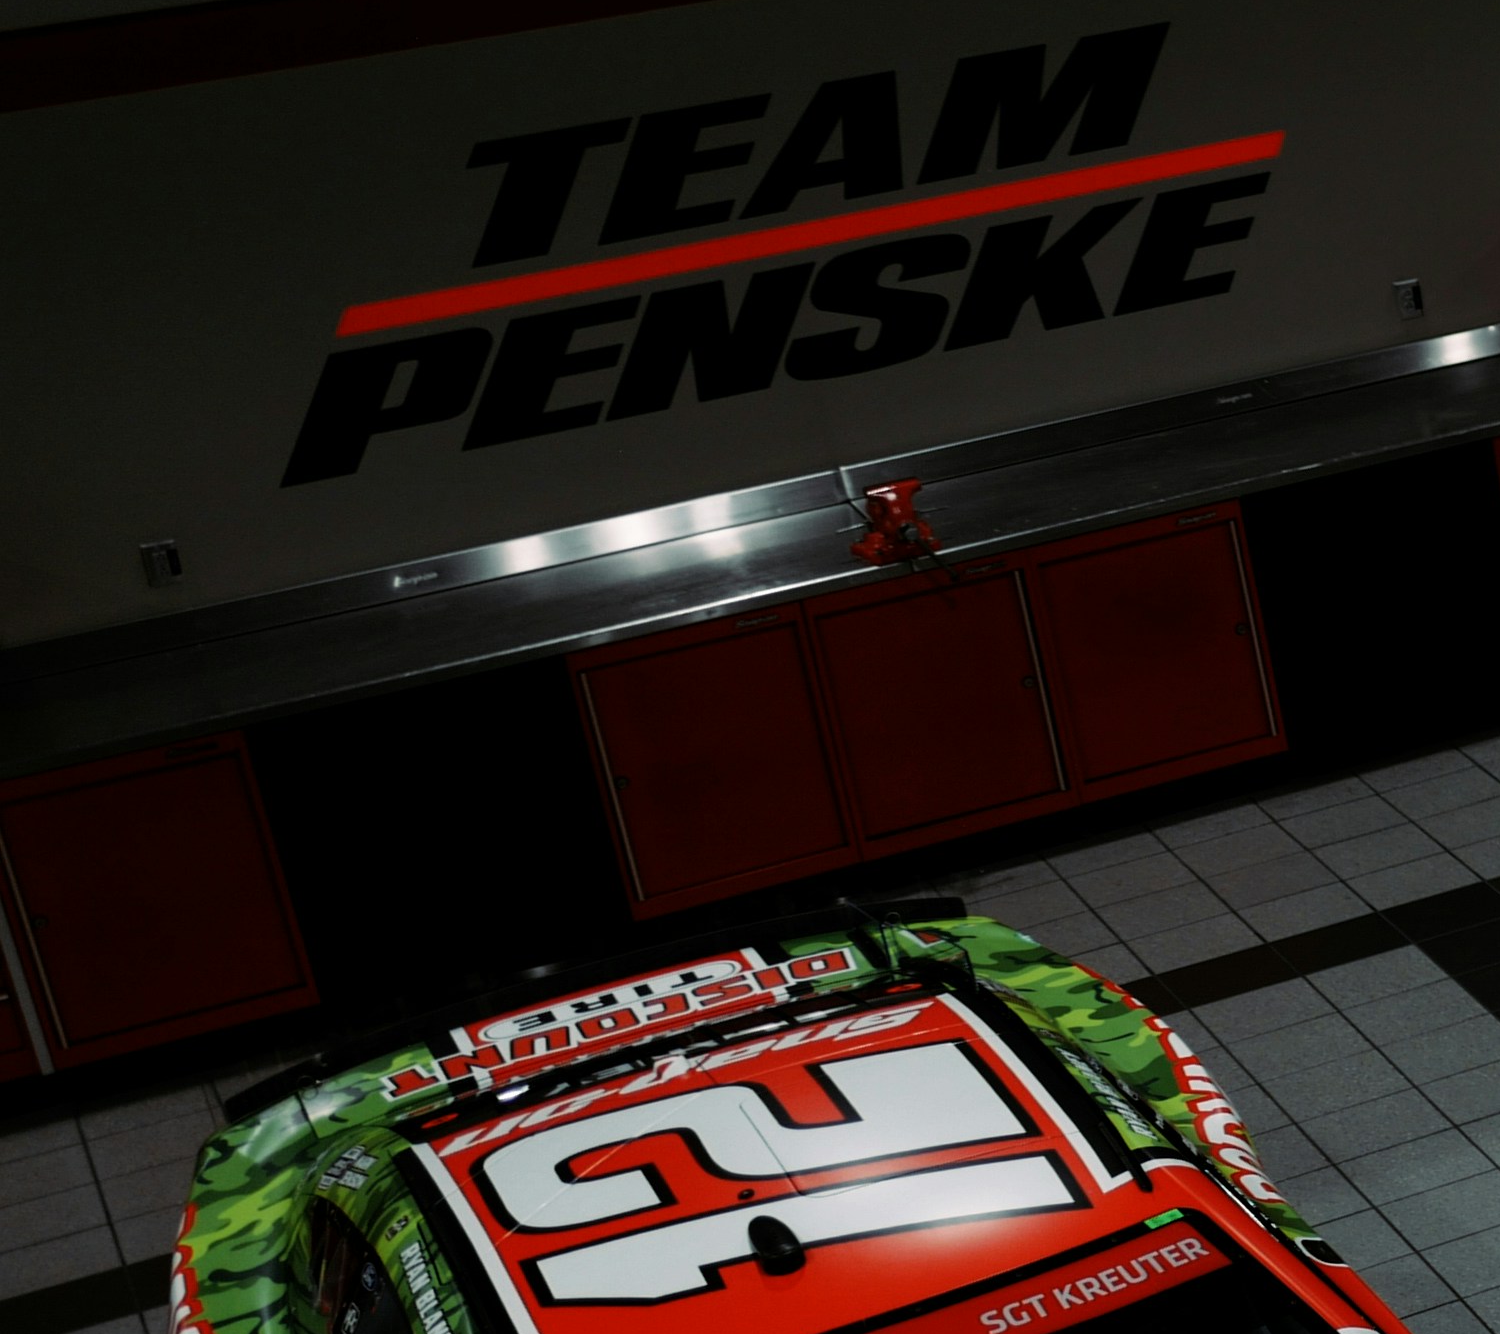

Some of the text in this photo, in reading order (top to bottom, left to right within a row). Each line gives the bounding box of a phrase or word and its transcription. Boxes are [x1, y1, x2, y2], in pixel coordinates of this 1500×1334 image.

[465, 21, 1171, 267] TEAM
[280, 173, 1271, 487] PENSKE
[384, 948, 856, 1101] DISCOUNT
[437, 998, 935, 1157] snap-on
[513, 971, 728, 1028] TIRE
[480, 1041, 1082, 1304] 12
[400, 1240, 431, 1293] RYAN
[1053, 1237, 1210, 1310] KREUTER
